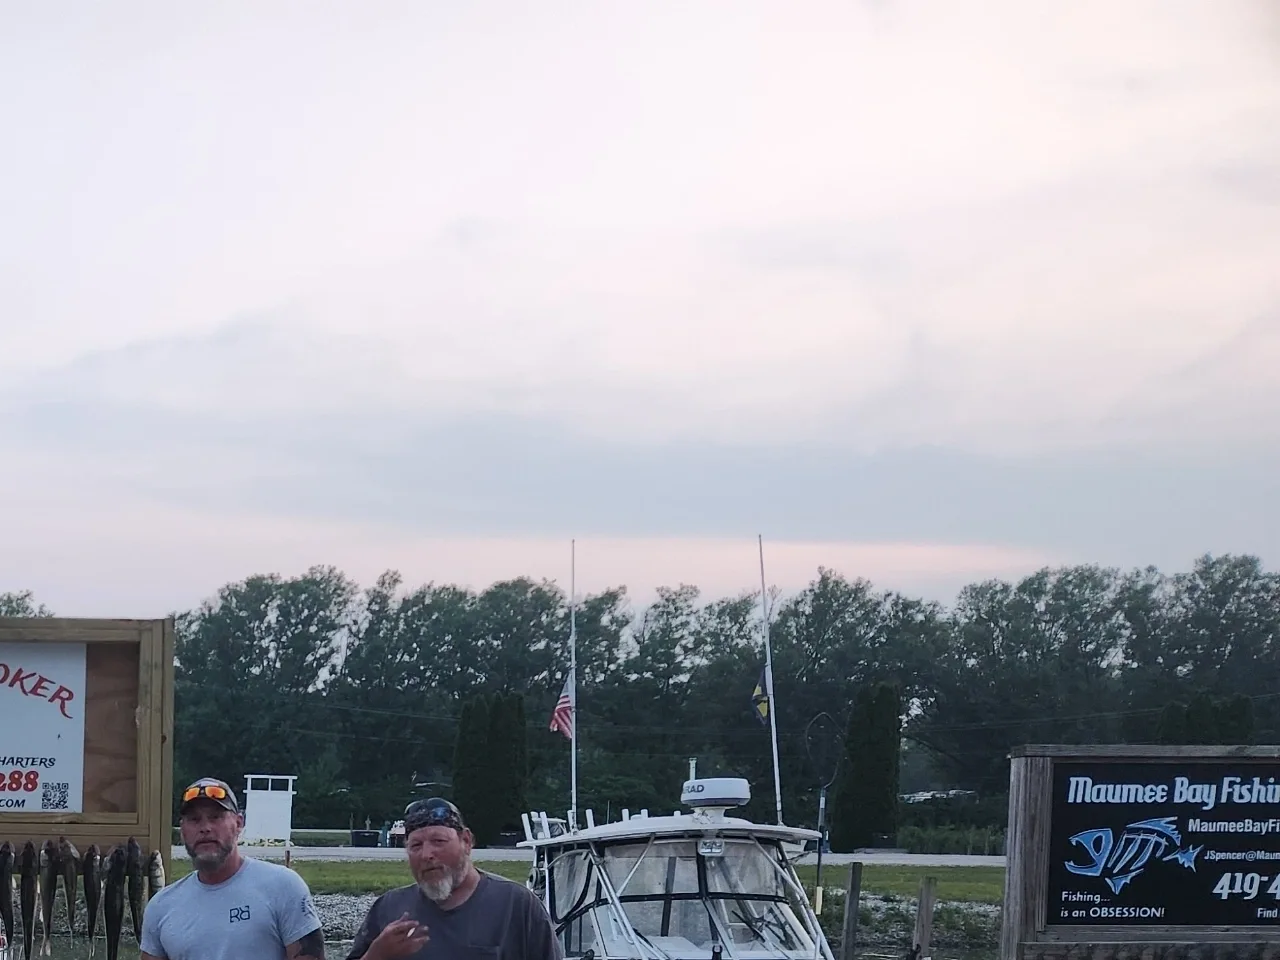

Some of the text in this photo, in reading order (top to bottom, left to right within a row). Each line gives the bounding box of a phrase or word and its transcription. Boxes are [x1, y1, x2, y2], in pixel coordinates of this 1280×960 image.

[1067, 776, 1169, 804] Maumee
[1173, 776, 1217, 810] Bay
[1061, 890, 1111, 904] Fishing...
[1060, 906, 1165, 918] is an OBSESSION!
[1257, 907, 1278, 918] Find
